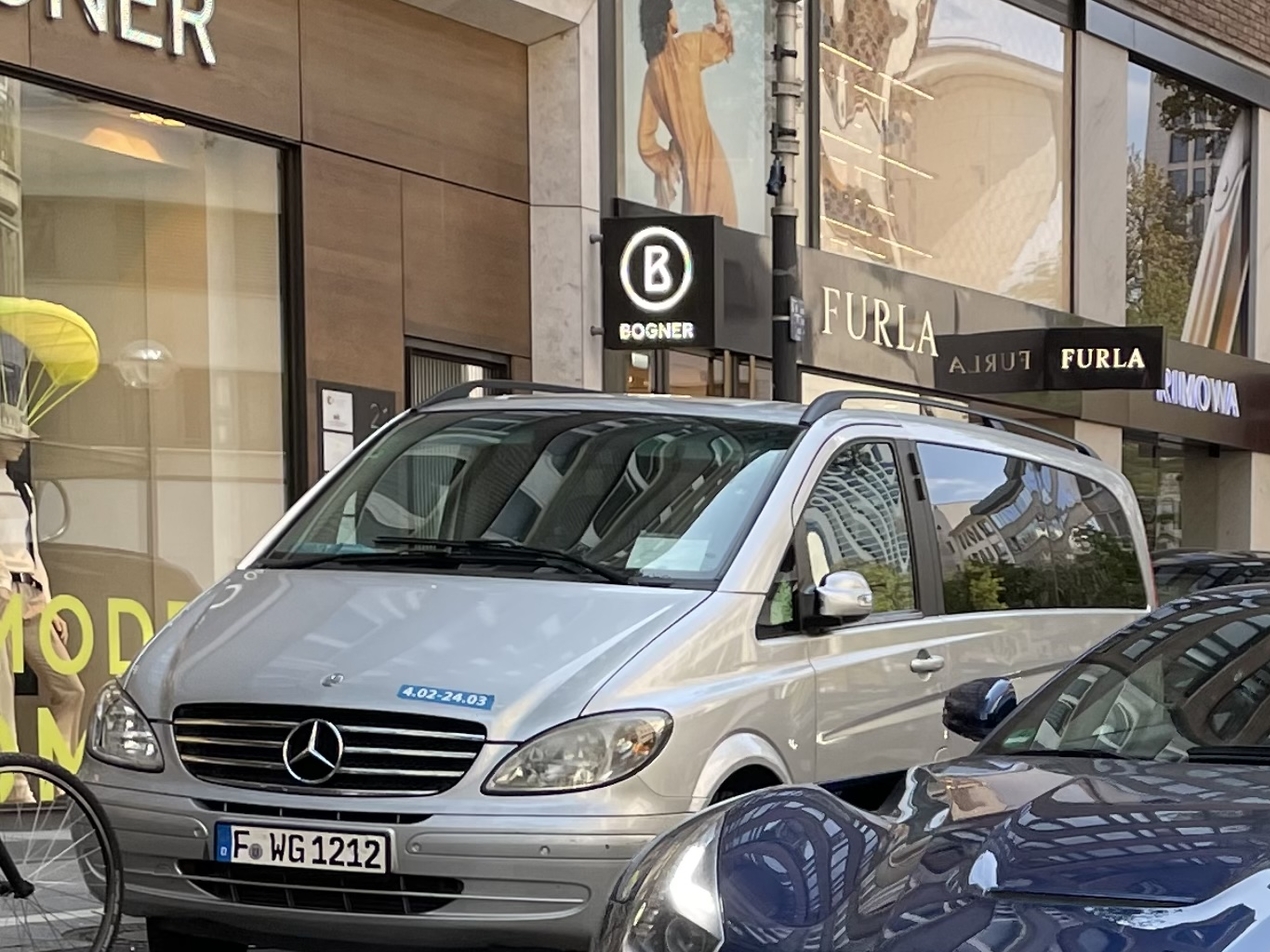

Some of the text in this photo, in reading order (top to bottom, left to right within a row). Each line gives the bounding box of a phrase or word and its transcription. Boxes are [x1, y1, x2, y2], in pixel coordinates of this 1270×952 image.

[619, 322, 695, 341] BOGNER
[822, 286, 939, 358] FURLA
[1061, 348, 1145, 369] FURLA
[1157, 367, 1240, 418] RIMOWA
[402, 687, 487, 706] 4.02-24.03
[234, 831, 250, 858] F
[270, 833, 304, 863] WG
[312, 836, 381, 869] 1212
